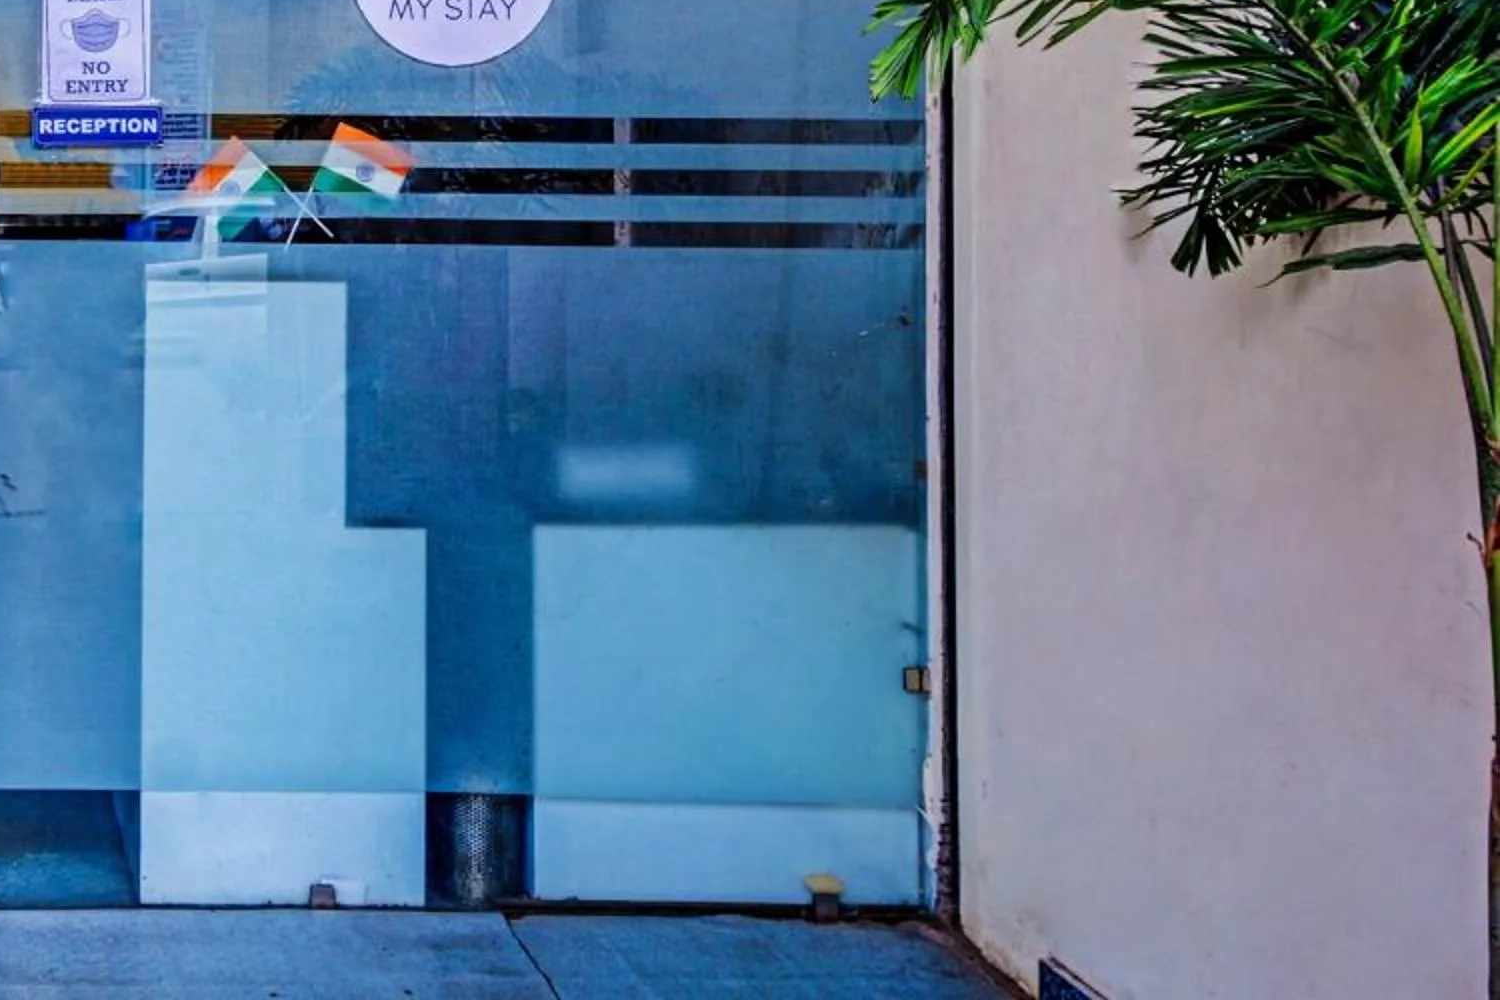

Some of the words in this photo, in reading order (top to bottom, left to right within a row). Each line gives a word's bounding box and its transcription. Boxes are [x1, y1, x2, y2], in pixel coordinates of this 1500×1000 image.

[82, 61, 111, 75] NO
[66, 79, 128, 94] ENTRY
[39, 118, 158, 134] RECEPTION
